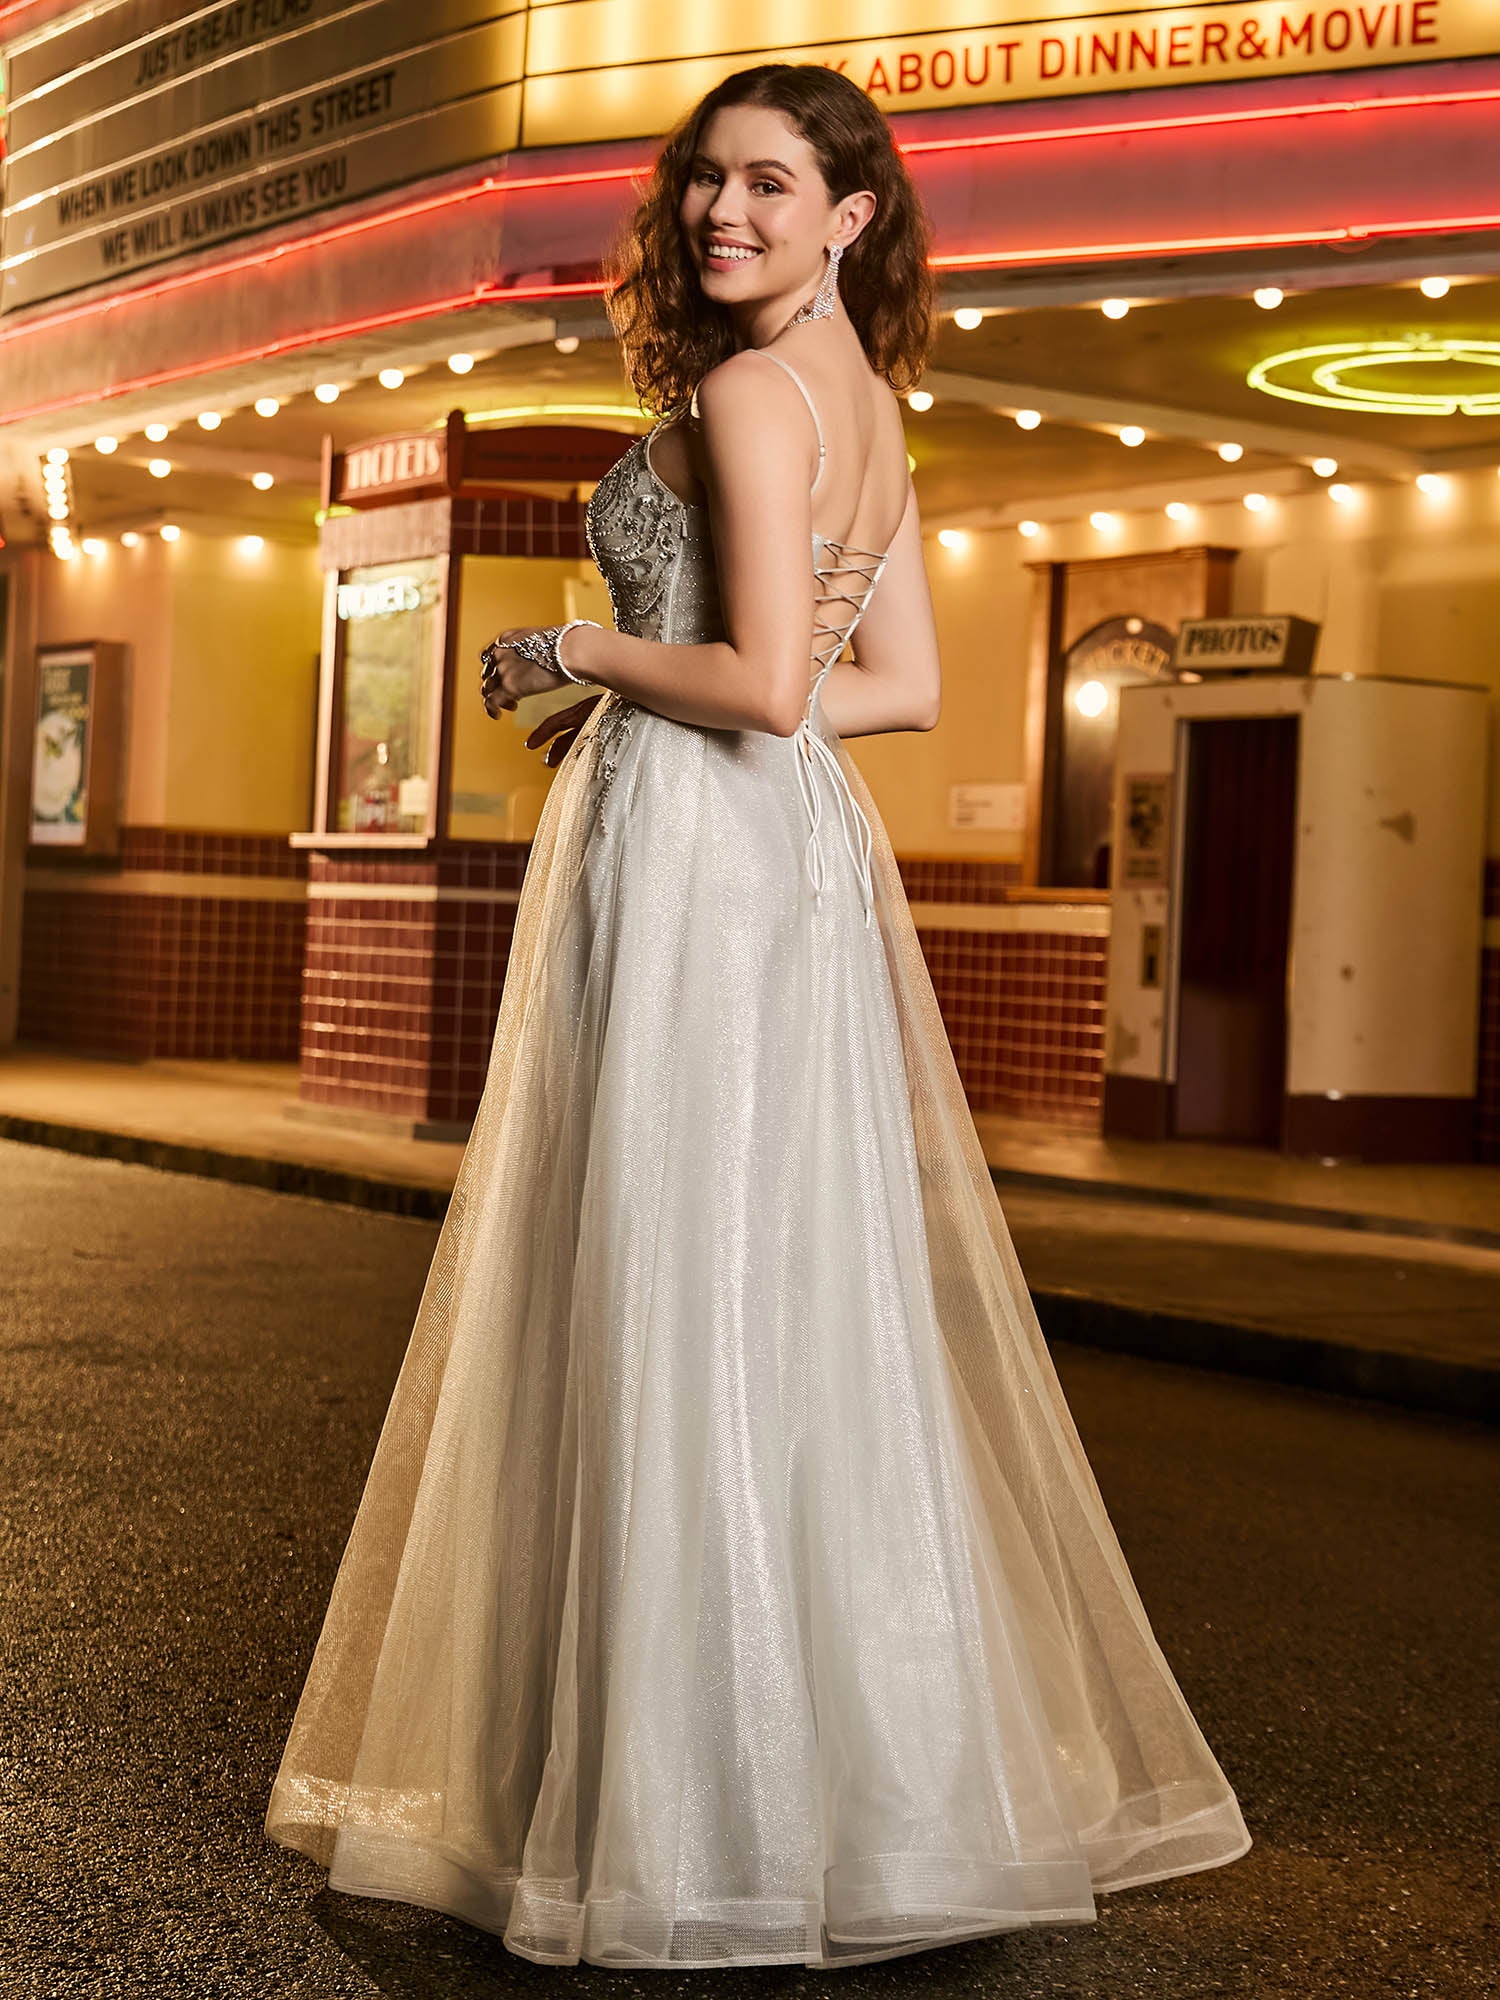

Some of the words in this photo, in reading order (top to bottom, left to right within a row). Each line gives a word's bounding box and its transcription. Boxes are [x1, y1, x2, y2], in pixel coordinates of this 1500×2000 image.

[136, 35, 181, 85] JUST
[185, 7, 246, 61] GREAT
[866, 41, 1021, 96] ABOUT
[58, 180, 106, 226] WHEN
[110, 169, 138, 206] WE
[139, 149, 189, 197] LOOK
[192, 127, 251, 179] DOWN
[256, 106, 301, 153] THIS
[311, 69, 396, 135] STREET
[102, 231, 131, 266] WE
[133, 214, 175, 256] WILL
[180, 185, 258, 240] ALWAYS
[262, 172, 300, 216] SEE
[304, 155, 348, 200] YOU
[346, 438, 441, 490] TICKETS
[1184, 626, 1283, 656] PHOTOS
